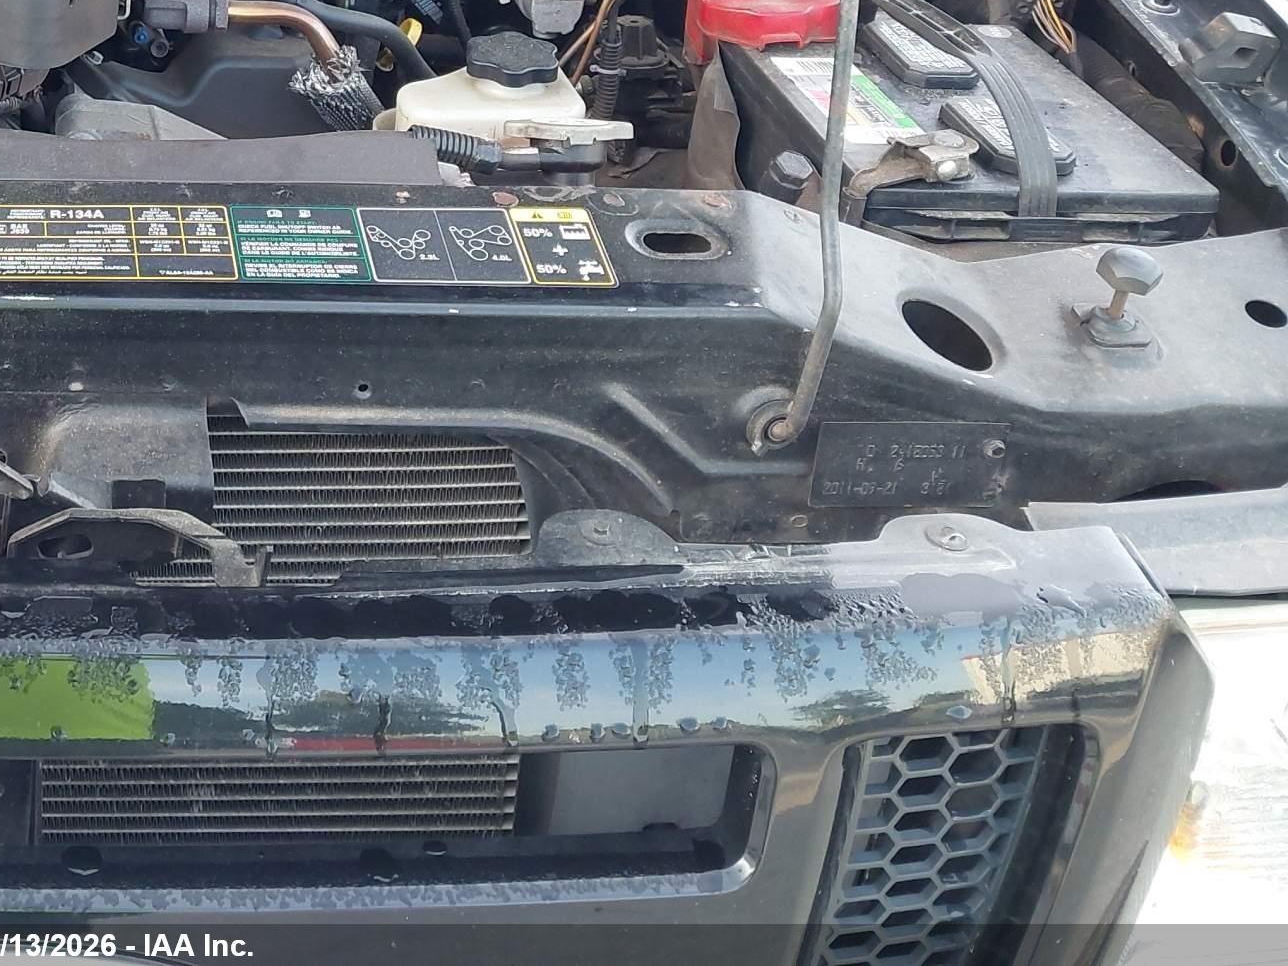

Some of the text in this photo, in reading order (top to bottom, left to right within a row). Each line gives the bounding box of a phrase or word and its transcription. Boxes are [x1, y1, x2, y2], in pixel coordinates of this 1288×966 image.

[50, 209, 105, 219] R-134A
[523, 227, 553, 238] 50%
[492, 254, 513, 262] 4.0L
[536, 264, 567, 274] 50%
